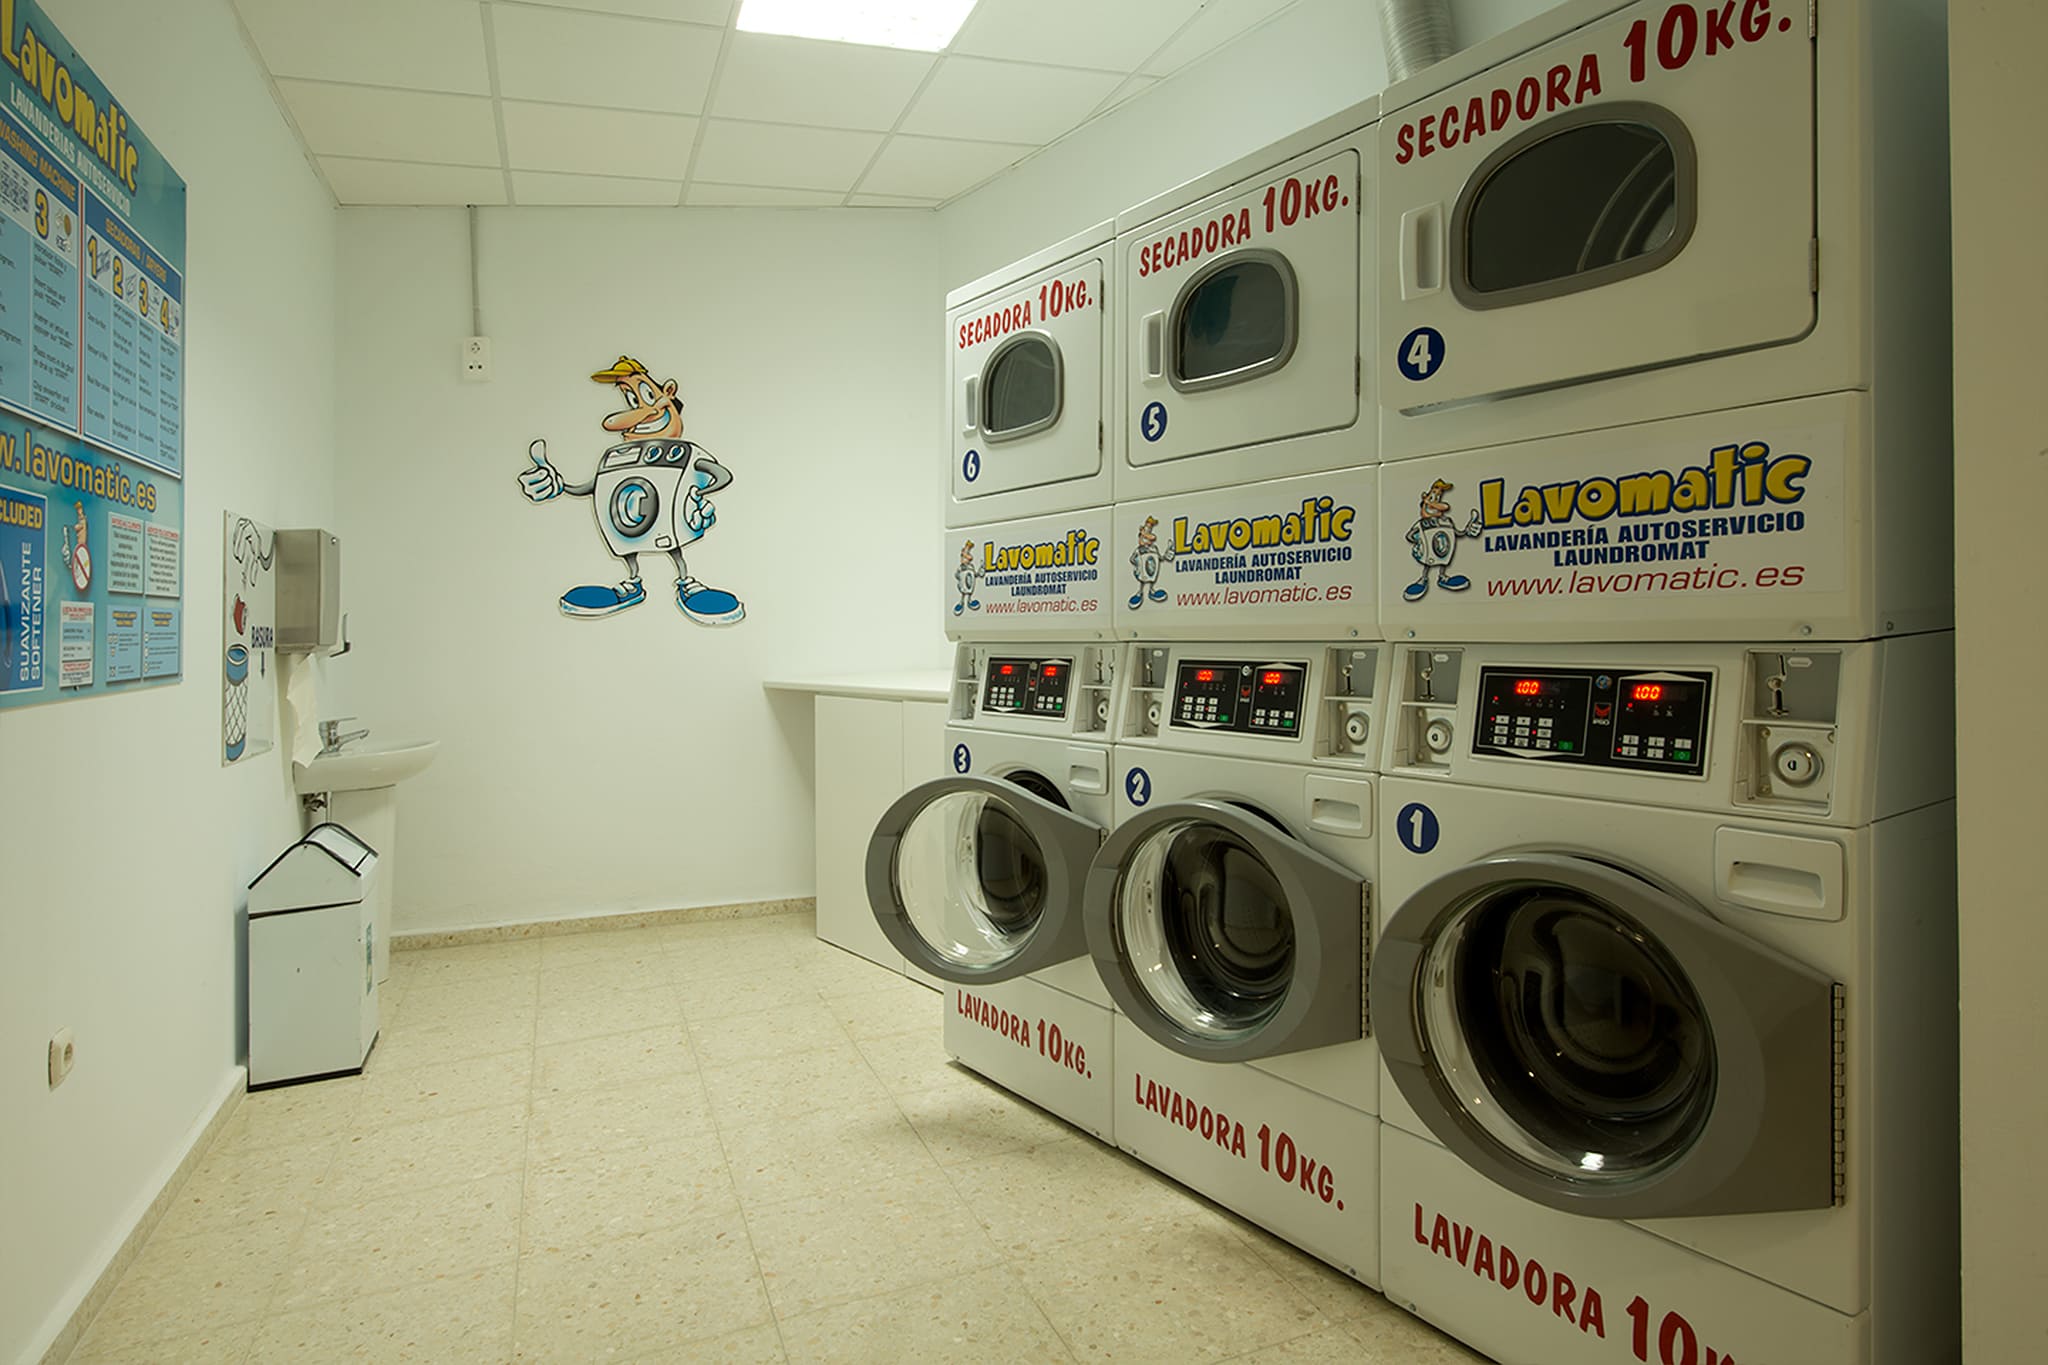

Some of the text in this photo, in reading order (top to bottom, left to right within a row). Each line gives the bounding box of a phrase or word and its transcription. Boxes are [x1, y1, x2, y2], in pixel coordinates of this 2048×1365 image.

[0, 0, 139, 196] Lavomatic
[1397, 0, 1789, 163] SECADORA 10KG.
[35, 188, 49, 240] 3
[1139, 175, 1348, 277] SECADORA 10KG.
[87, 235, 98, 280] 1
[113, 255, 124, 300] 2
[138, 277, 149, 317] 3
[161, 296, 170, 335] 4
[959, 279, 1093, 349] SECADORA 10KG.
[1407, 334, 1433, 374] 4
[1479, 441, 1811, 530] Lavomatic
[984, 529, 1100, 572] Lavomatic
[1173, 496, 1356, 555] Lavomatic
[1484, 511, 1805, 553] LAVANDERÍA AUTOSERVICIO
[985, 569, 1098, 587] LAVANDERÍA AUTOSERVICIO
[1176, 546, 1352, 573] LAVANDERÍA AUTOSERVICIO
[1215, 566, 1302, 584] LAUNDROMAT
[1487, 563, 1806, 597] www.lavomatic.es
[1553, 540, 1711, 567] LAUNDROMAT
[20, 542, 32, 681] SUAVIZANTE
[986, 597, 1098, 614] www.lavomatic.es
[1011, 583, 1067, 597] LAUNDROMAT
[1177, 582, 1352, 606] www.lavomatic.es
[32, 567, 42, 680] SOFTENER
[957, 991, 1092, 1078] LAVADORA 10KG.
[1135, 1074, 1344, 1209] LAVADORA 10KG.
[1414, 1204, 1605, 1336] LAVADORA
